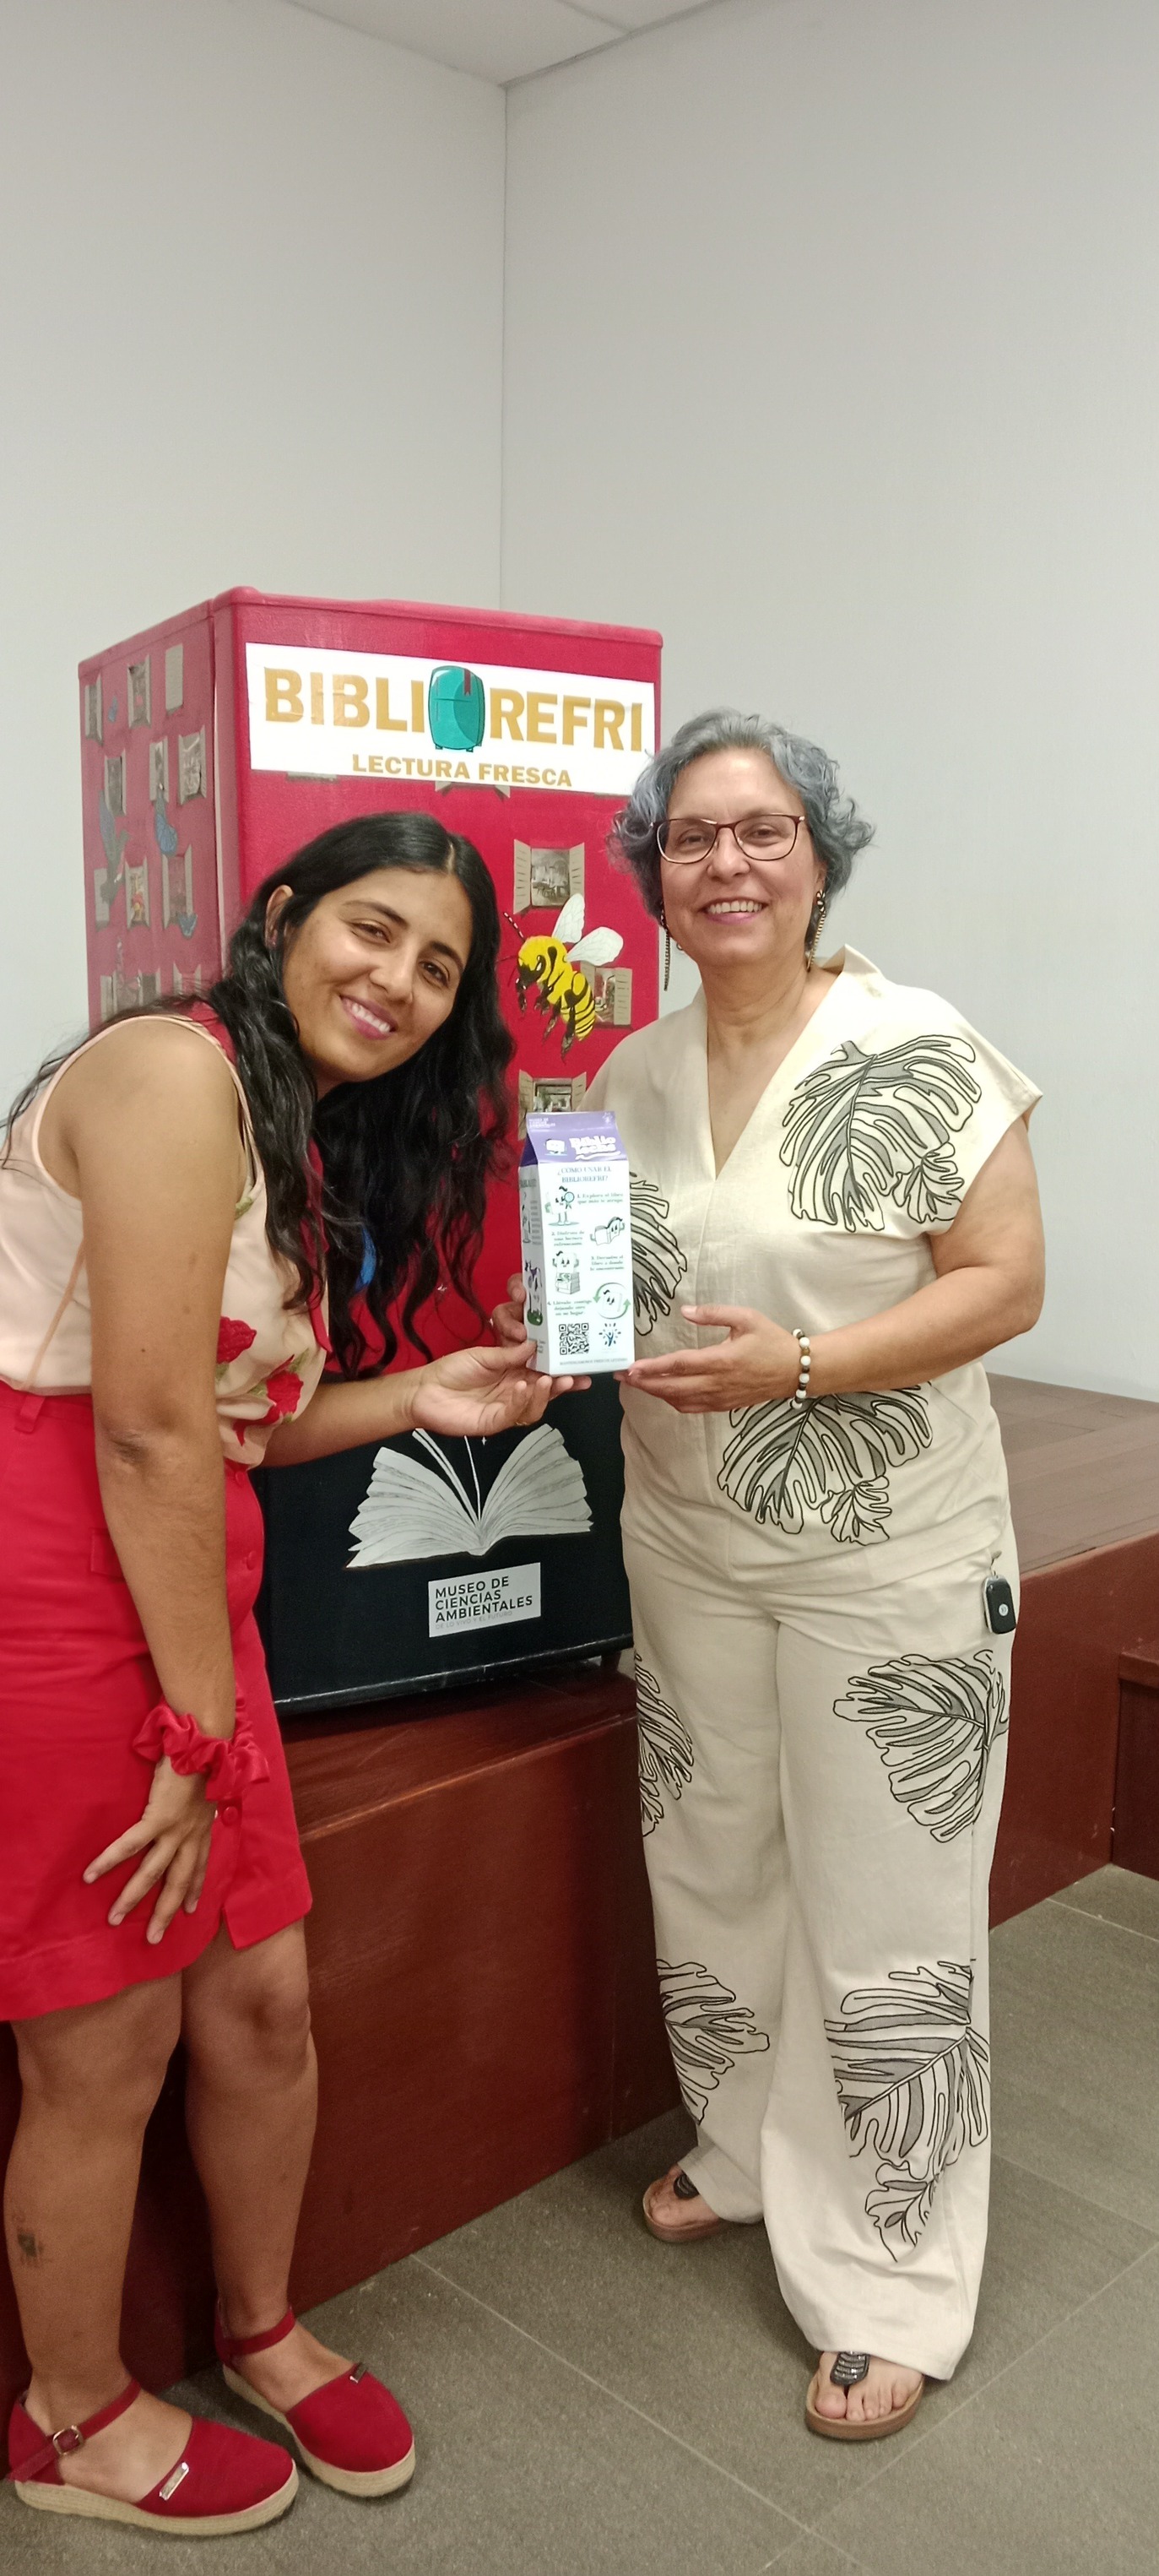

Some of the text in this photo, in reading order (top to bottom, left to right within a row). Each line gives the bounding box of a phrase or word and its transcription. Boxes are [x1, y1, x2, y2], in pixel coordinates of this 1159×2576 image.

[351, 753, 572, 788] LECTURA FRESCA
[436, 1575, 510, 1599] MUSEO DE
[435, 1590, 501, 1611] CIENCIAS
[435, 1595, 533, 1624] AMBIENTALES
[487, 1610, 513, 1621] FUTURO
